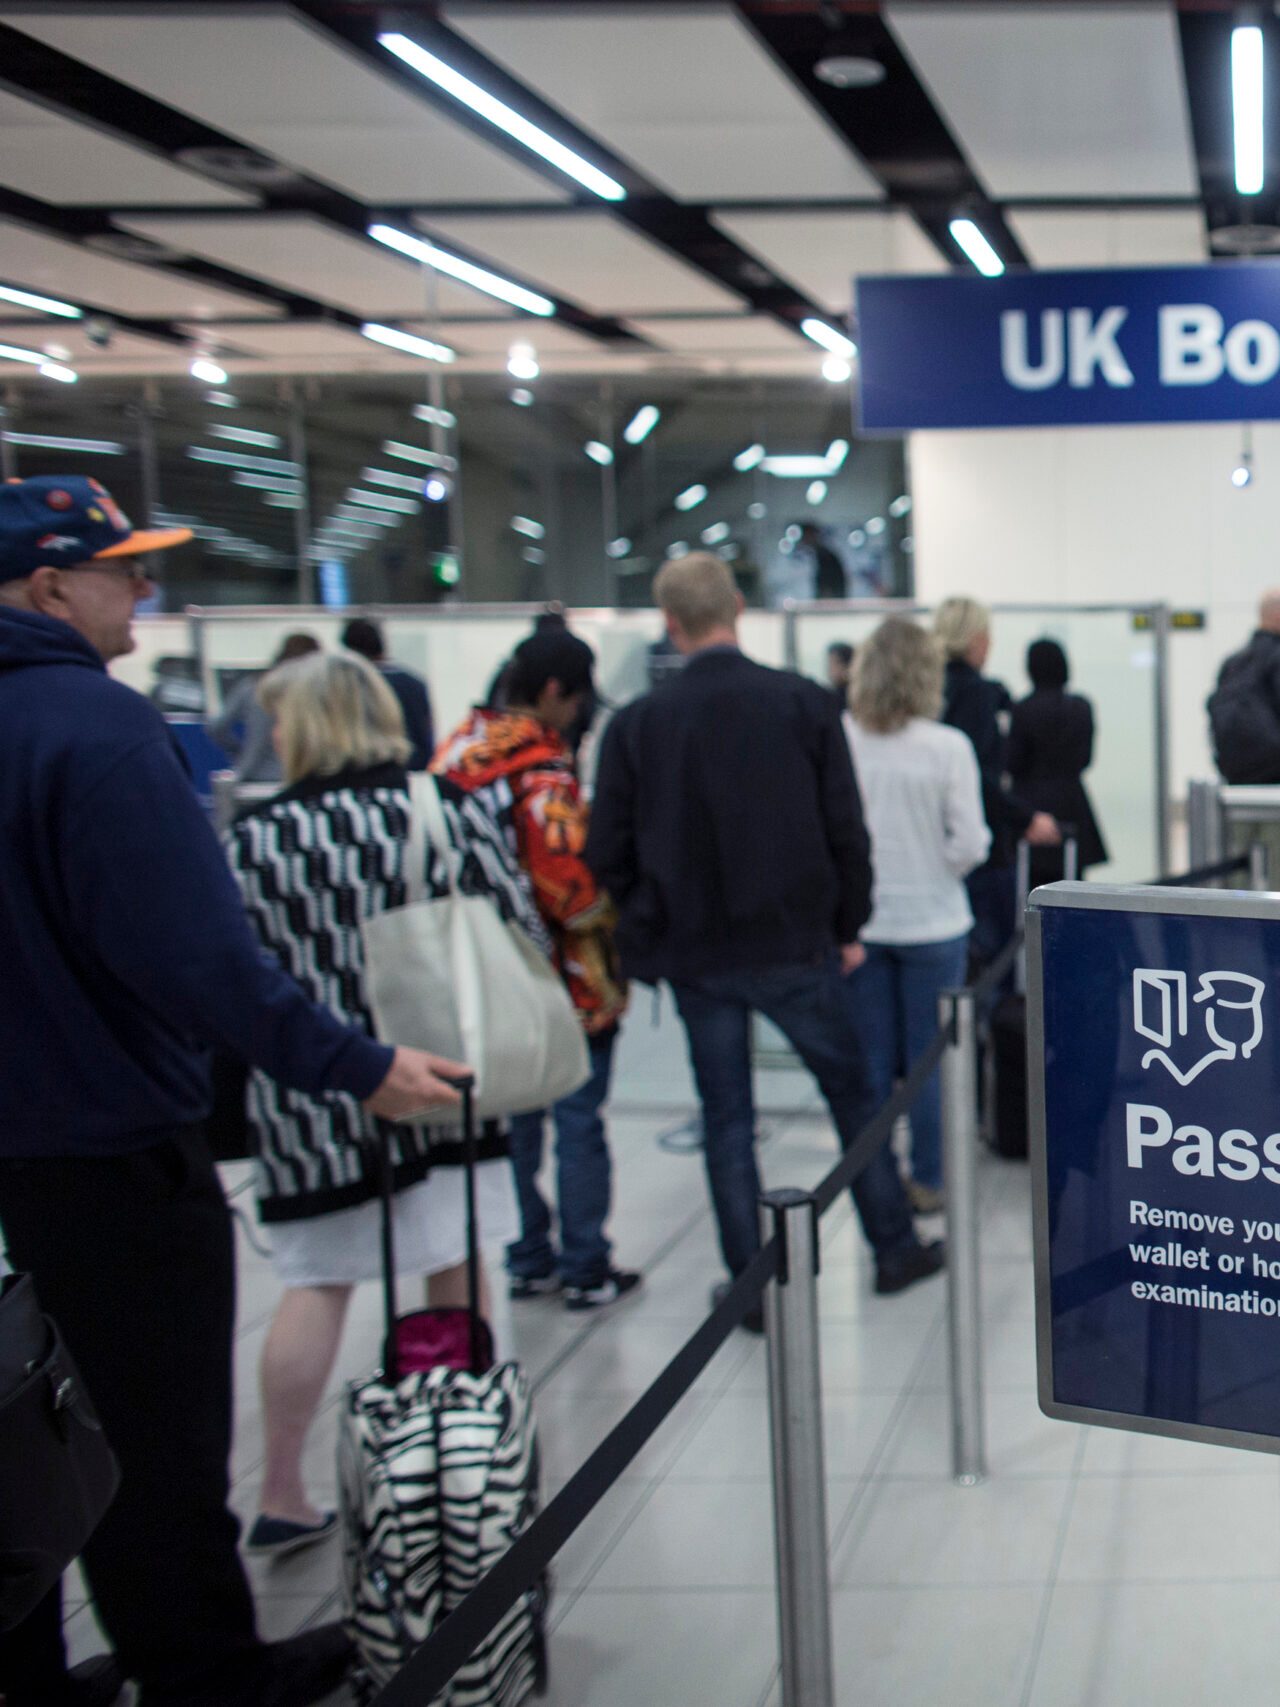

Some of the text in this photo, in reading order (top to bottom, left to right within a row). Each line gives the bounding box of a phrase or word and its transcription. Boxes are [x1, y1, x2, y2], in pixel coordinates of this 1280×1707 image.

[1003, 307, 1133, 389] UK
[1129, 1200, 1234, 1236] Remove
[1128, 1242, 1210, 1271] wallet
[1217, 1254, 1245, 1274] or
